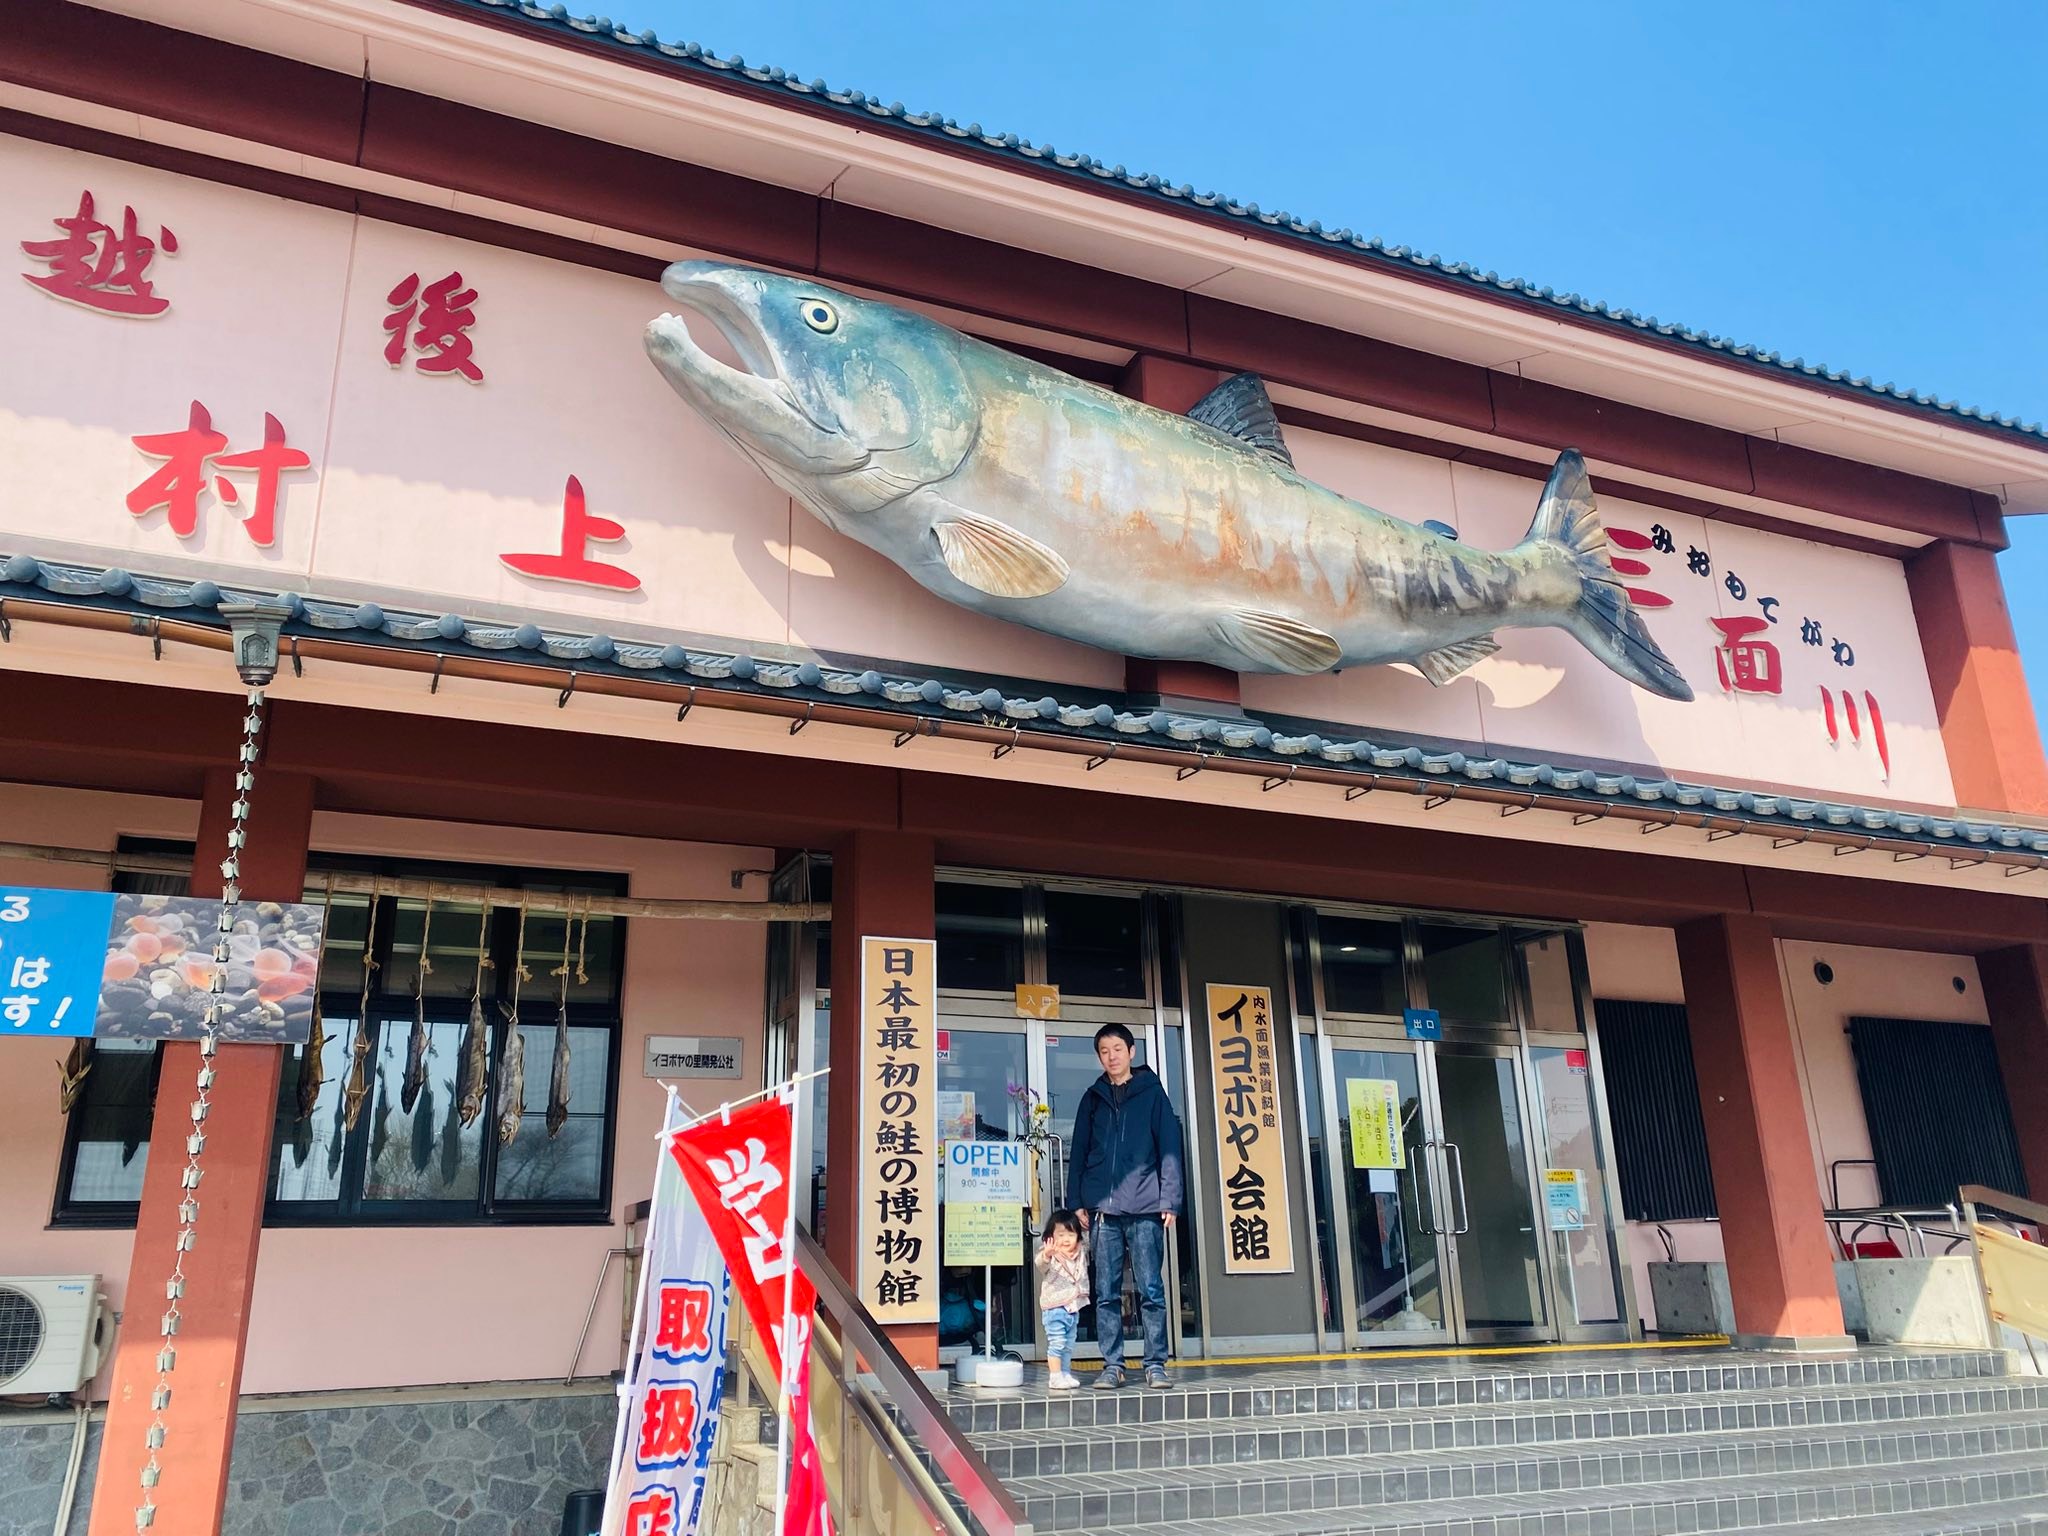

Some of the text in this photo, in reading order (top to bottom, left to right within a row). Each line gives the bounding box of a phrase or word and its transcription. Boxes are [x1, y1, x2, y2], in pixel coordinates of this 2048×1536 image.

[1603, 526, 1891, 784] 三面川
[1650, 523, 1855, 668] みおもてがわ
[652, 1053, 734, 1070] イヨボヤの里開発公社
[1252, 994, 1276, 1128] 内水面漁業資料館
[1413, 1018, 1435, 1030] 出口
[874, 946, 924, 1307] 日本最初の鮭の博物館
[952, 1144, 1018, 1166] OPEN
[971, 1167, 1000, 1178] 開館中
[1216, 992, 1271, 1262] イヨボヤ会館
